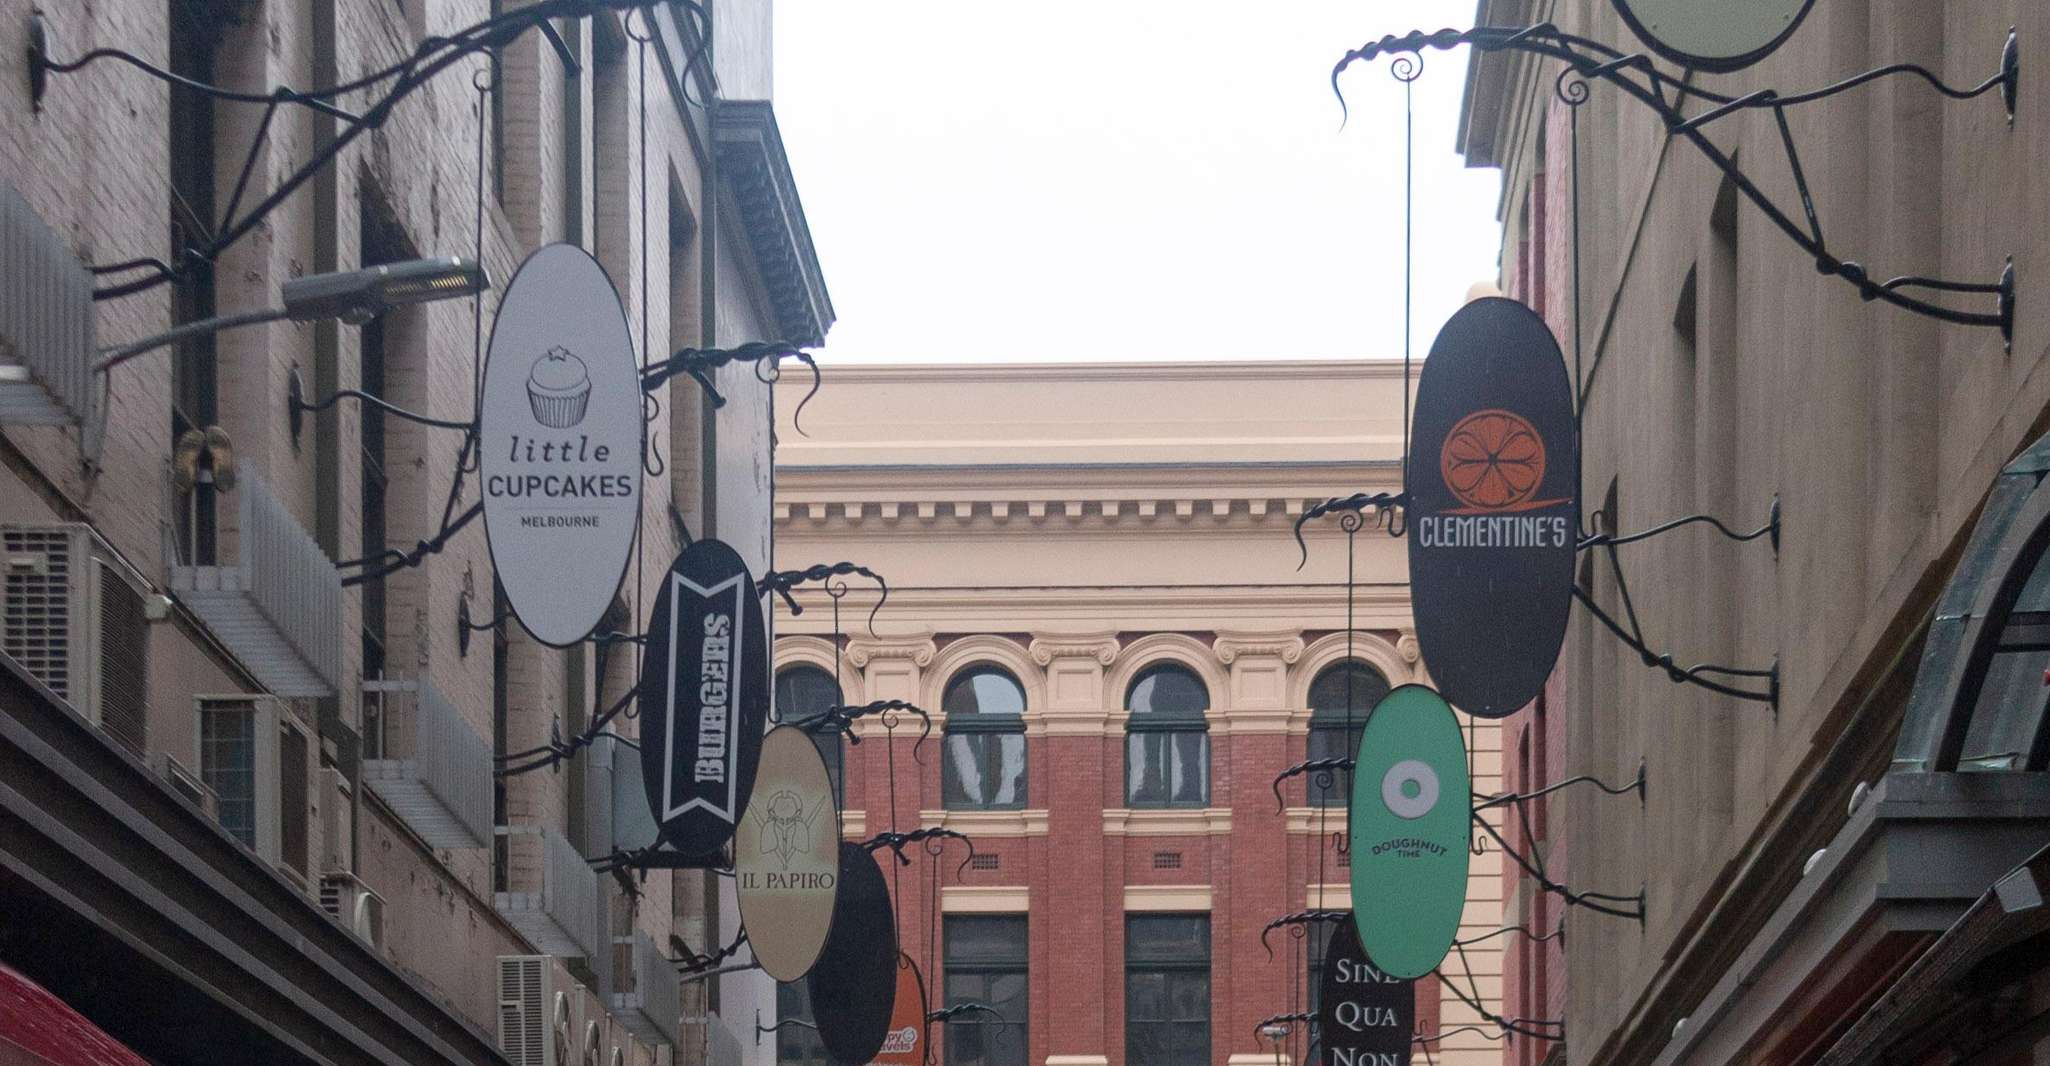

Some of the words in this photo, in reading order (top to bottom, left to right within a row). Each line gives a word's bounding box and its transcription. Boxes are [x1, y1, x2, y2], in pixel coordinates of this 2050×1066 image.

[510, 435, 610, 462] little
[488, 475, 632, 497] CUPCAKES
[521, 516, 600, 528] MELBOURNE
[1420, 517, 1566, 547] CLEMENTINE'S
[694, 612, 731, 783] BURGERS
[1371, 838, 1447, 857] DOUGHNUT
[1397, 850, 1421, 858] TIME
[742, 872, 760, 889] IL
[766, 872, 834, 889] PAPIRO
